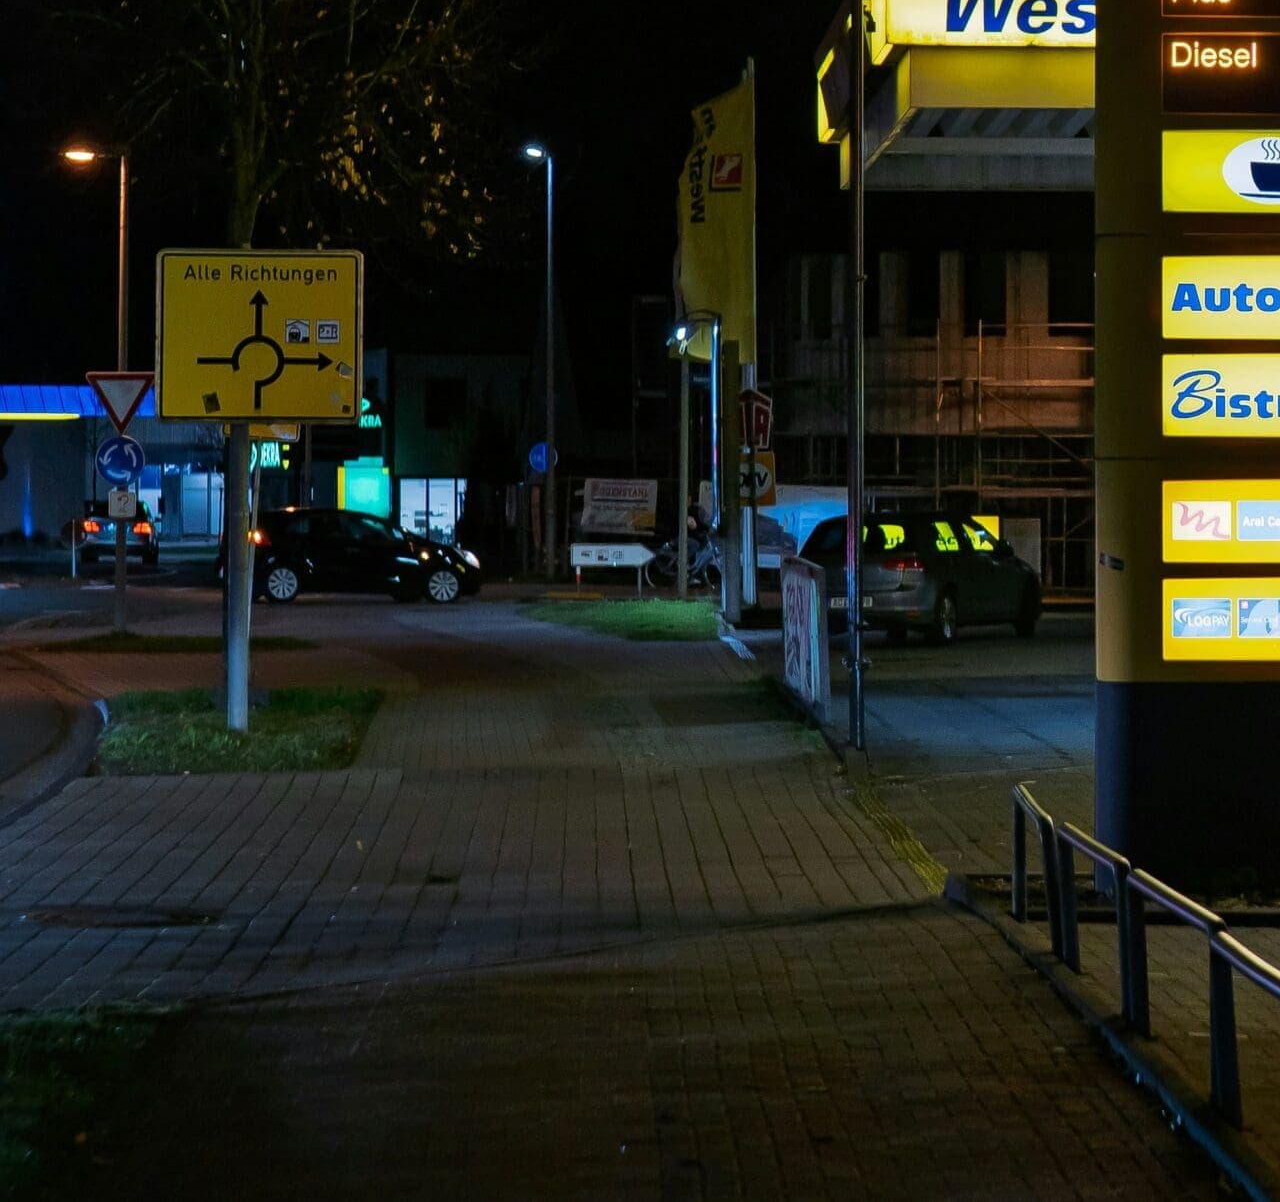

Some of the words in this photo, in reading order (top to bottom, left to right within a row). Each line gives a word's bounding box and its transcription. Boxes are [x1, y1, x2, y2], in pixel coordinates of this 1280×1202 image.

[1171, 42, 1257, 68] Diesel
[184, 264, 221, 281] Alle
[231, 264, 338, 285] Richtungen
[359, 414, 382, 428] KRA
